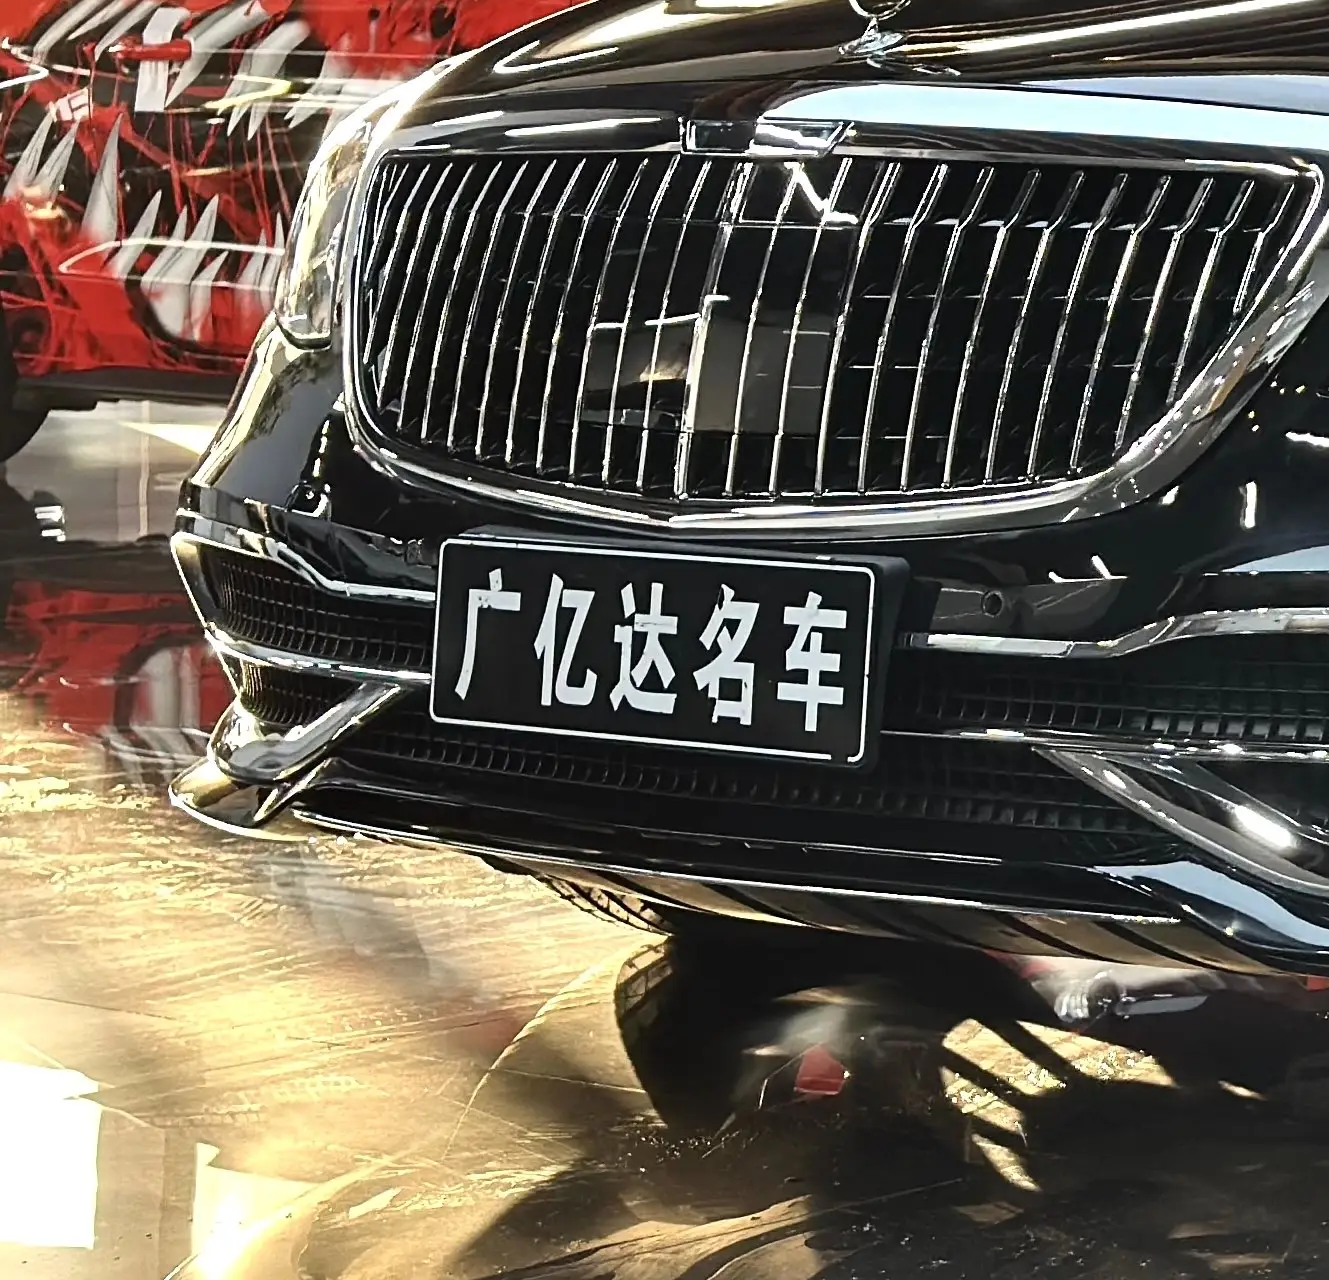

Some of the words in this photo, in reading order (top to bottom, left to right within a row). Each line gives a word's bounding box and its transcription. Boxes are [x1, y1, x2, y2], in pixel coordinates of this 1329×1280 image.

[454, 567, 848, 732] 广亿达名车
